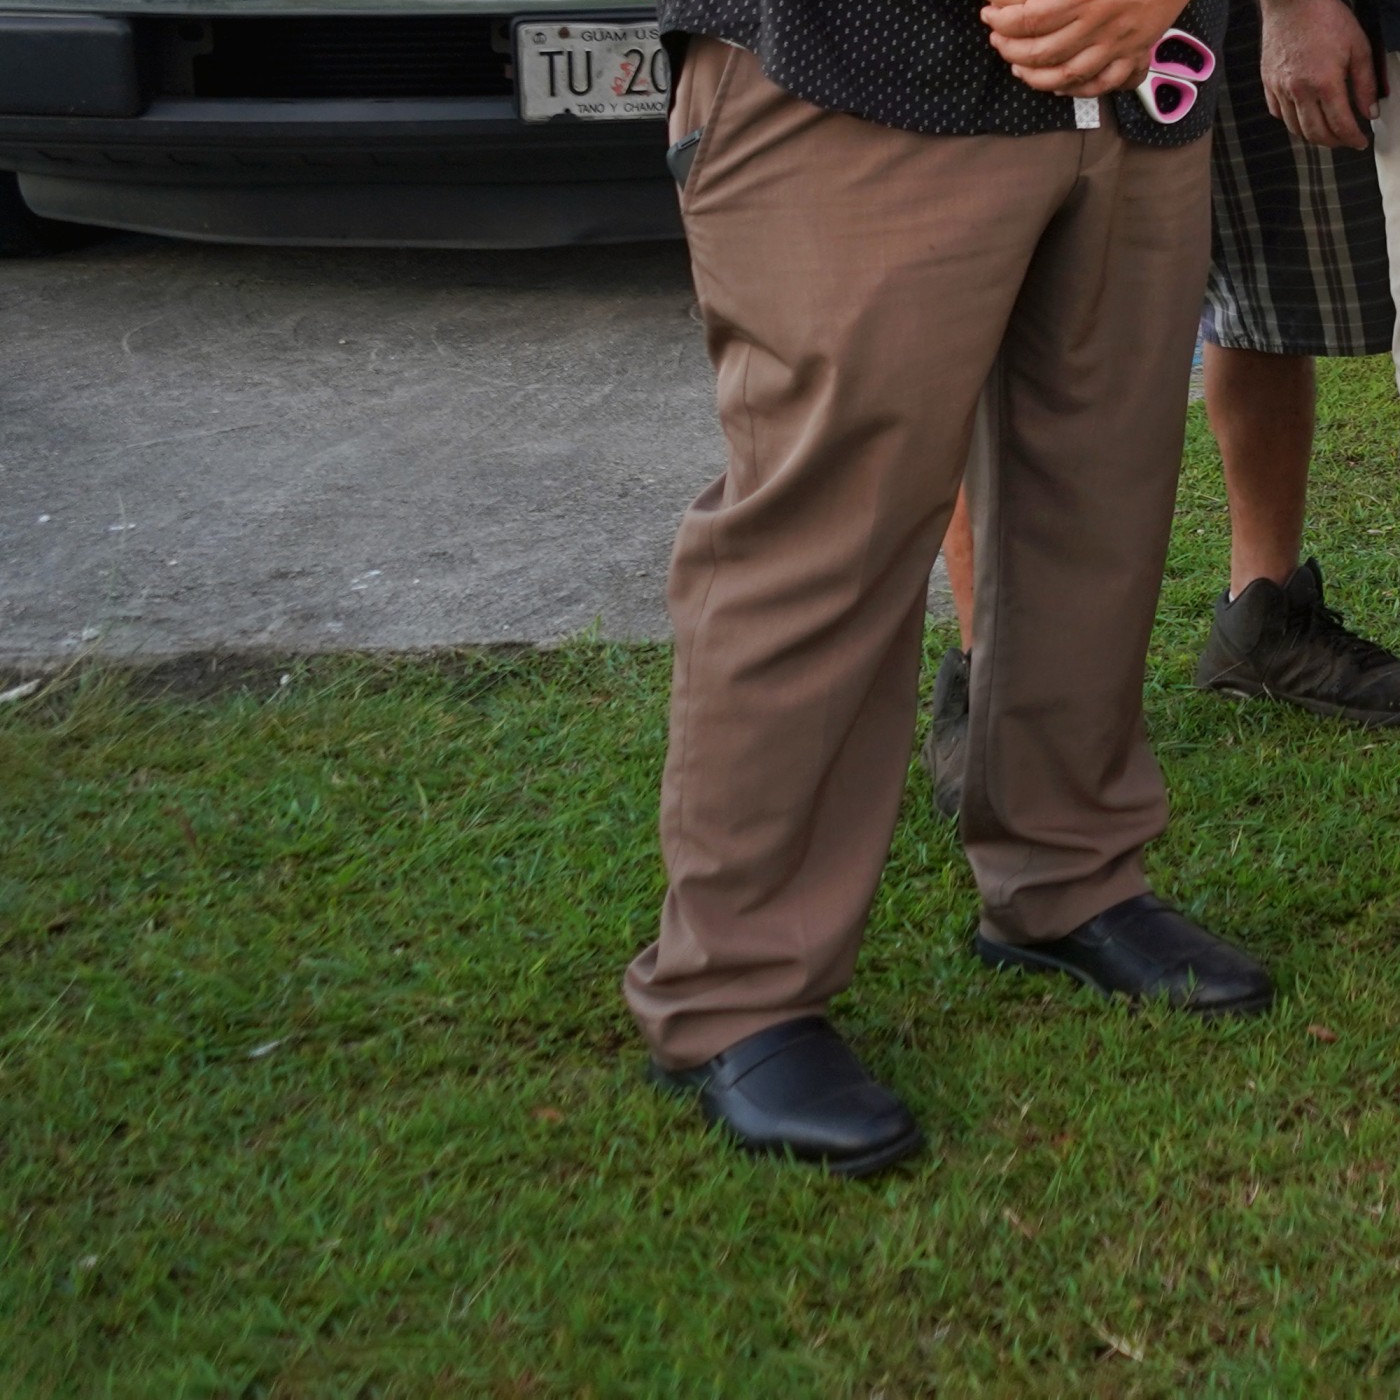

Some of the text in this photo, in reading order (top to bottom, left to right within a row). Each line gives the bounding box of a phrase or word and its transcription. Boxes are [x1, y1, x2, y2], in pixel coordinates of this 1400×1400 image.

[581, 30, 660, 42] GUAM U.S
[540, 50, 592, 97] TU
[610, 103, 618, 113] Y
[624, 103, 666, 112] CHAMO
